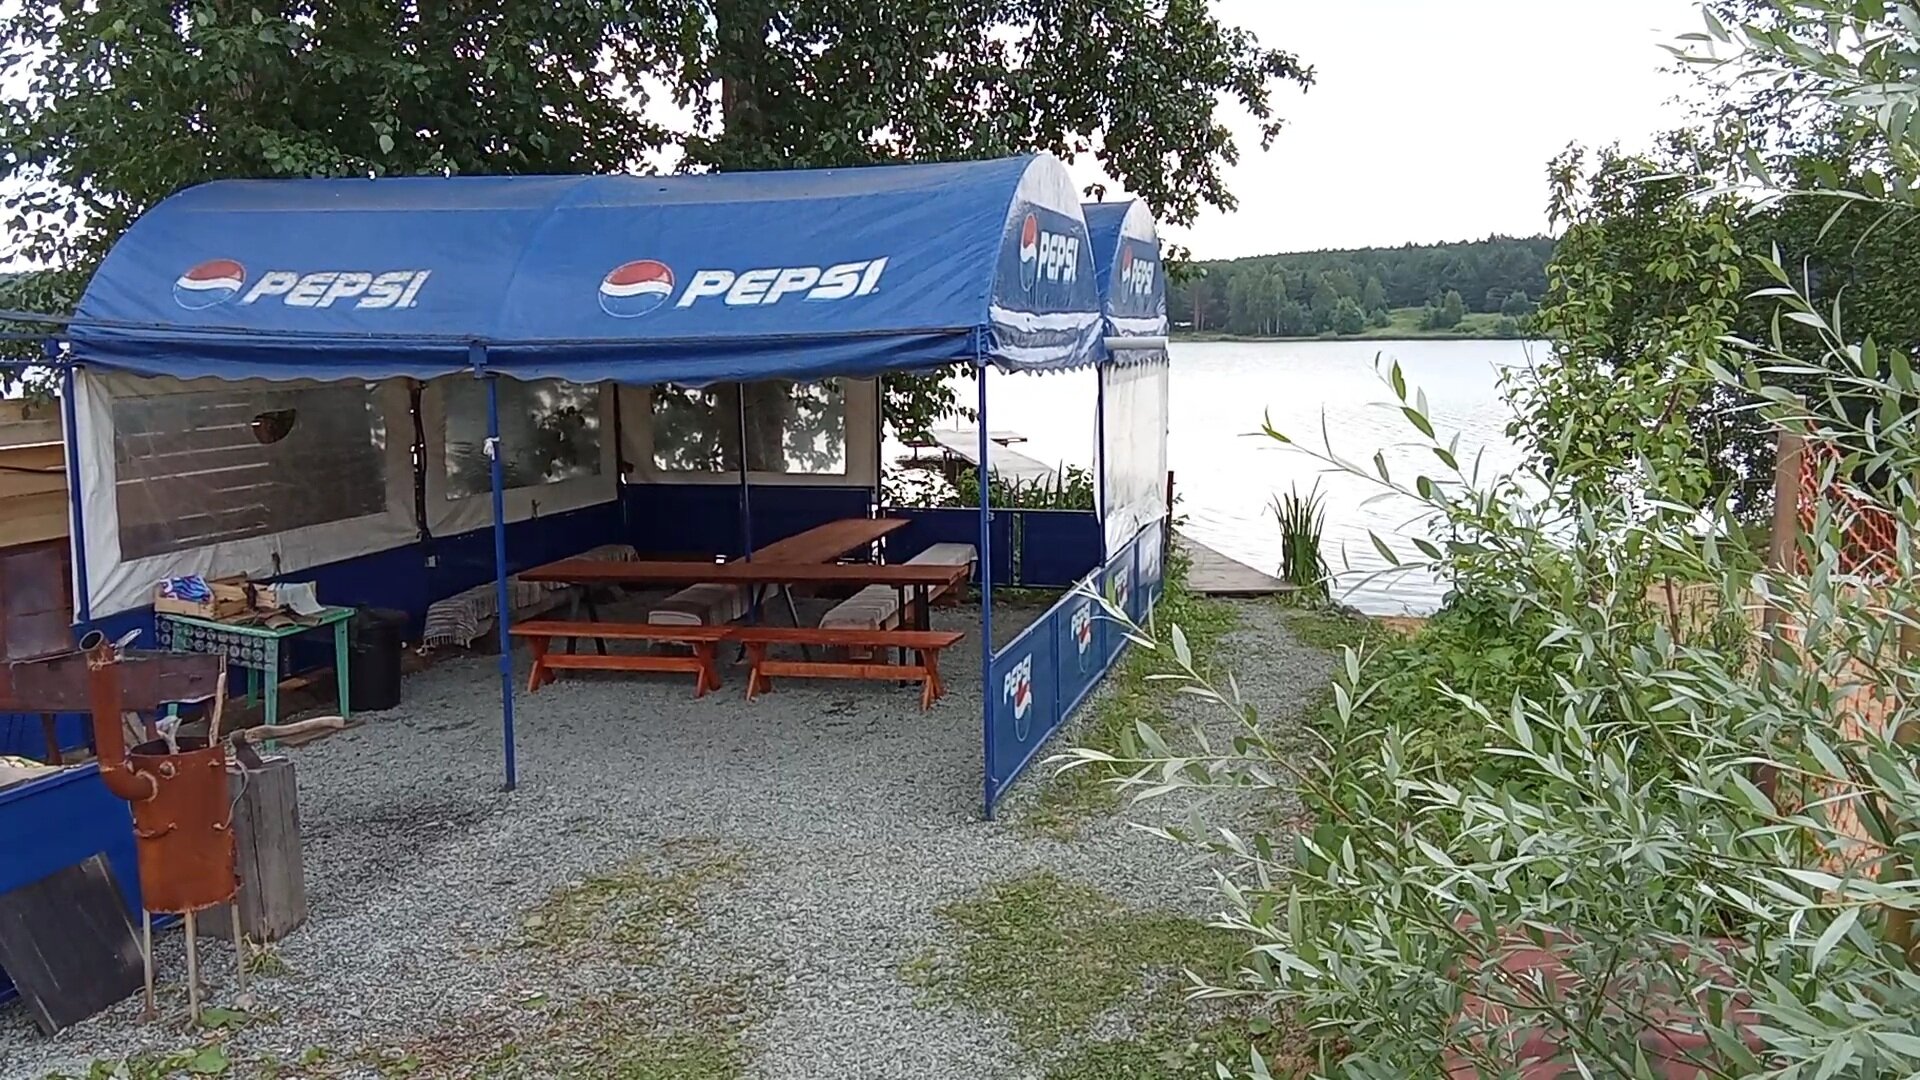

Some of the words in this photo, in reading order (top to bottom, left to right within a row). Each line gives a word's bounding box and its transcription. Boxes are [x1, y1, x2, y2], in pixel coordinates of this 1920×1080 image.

[1037, 231, 1079, 283] PEPSI
[1130, 258, 1154, 294] PEPSI
[1071, 601, 1091, 640] PEPSI
[1003, 653, 1032, 704] PEPSI
